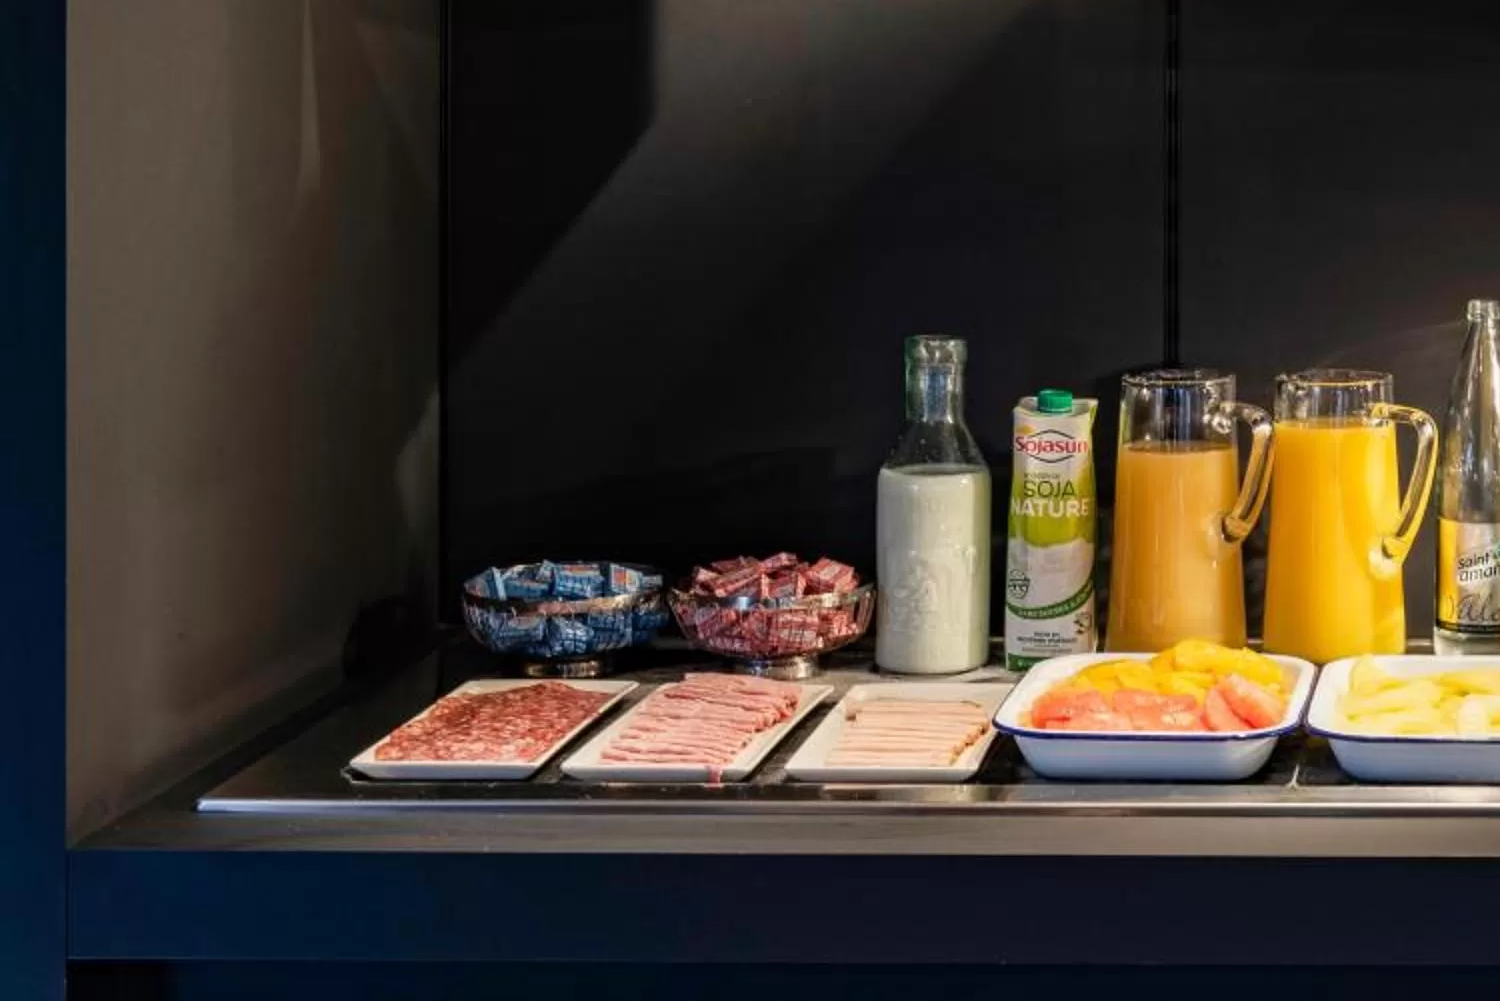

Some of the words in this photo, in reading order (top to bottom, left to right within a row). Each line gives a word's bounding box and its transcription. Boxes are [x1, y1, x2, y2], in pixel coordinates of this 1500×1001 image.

[1015, 436, 1088, 455] Sojasun
[1023, 479, 1077, 499] SOJA
[1011, 498, 1090, 517] NATURE
